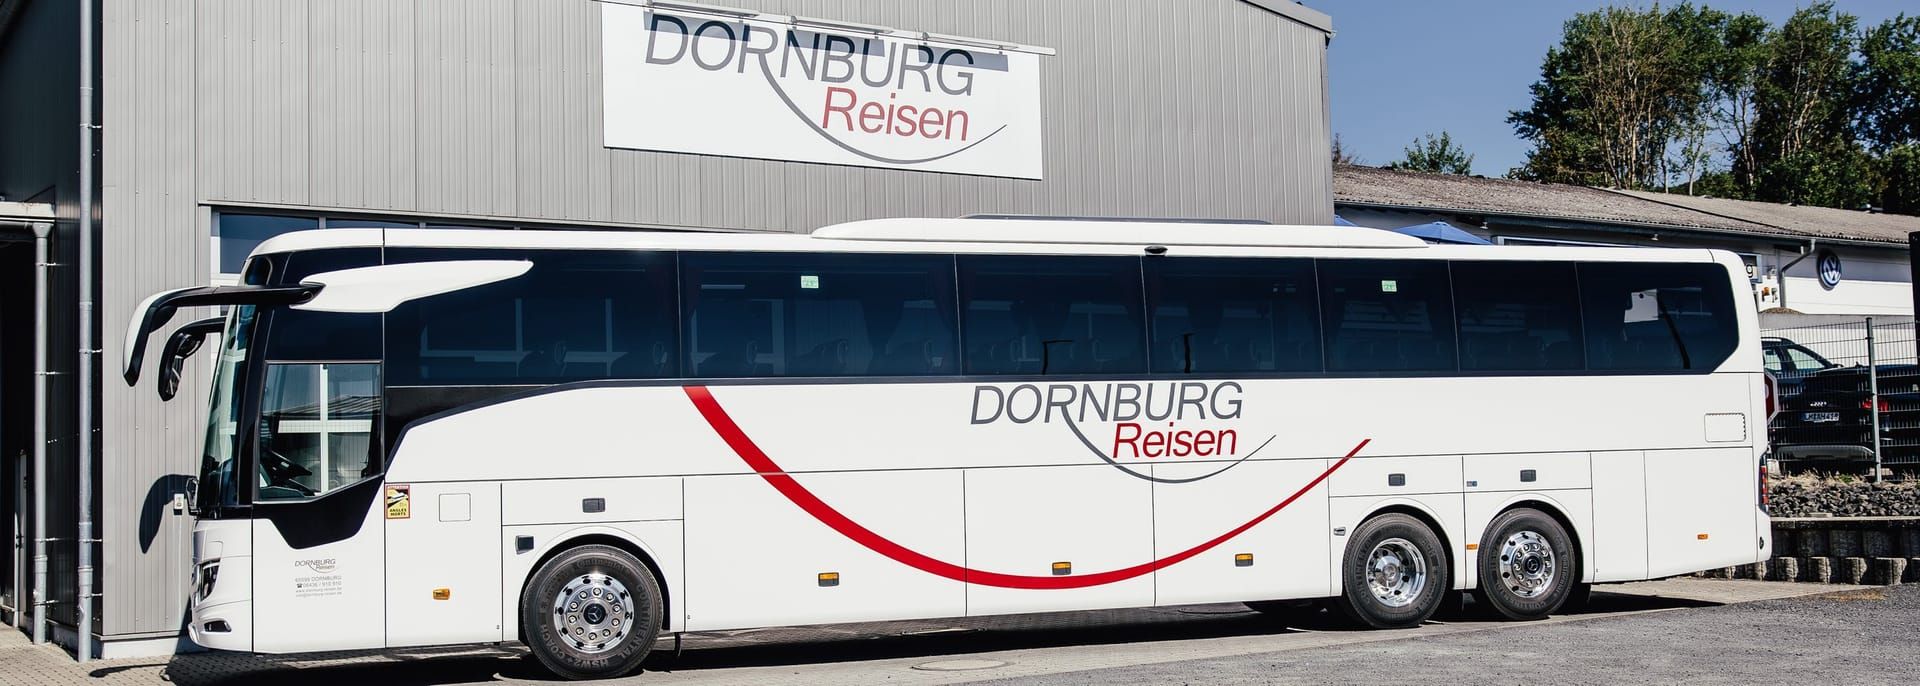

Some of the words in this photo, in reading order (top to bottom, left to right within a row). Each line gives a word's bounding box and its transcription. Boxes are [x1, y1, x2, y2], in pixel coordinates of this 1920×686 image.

[645, 13, 975, 96] DORNBURG
[822, 86, 969, 141] Reisen
[971, 381, 1243, 425] DORNBURG
[1112, 422, 1237, 458] Reisen
[295, 559, 336, 567] DORNBURG
[620, 583, 651, 660] CONTINENTAL
